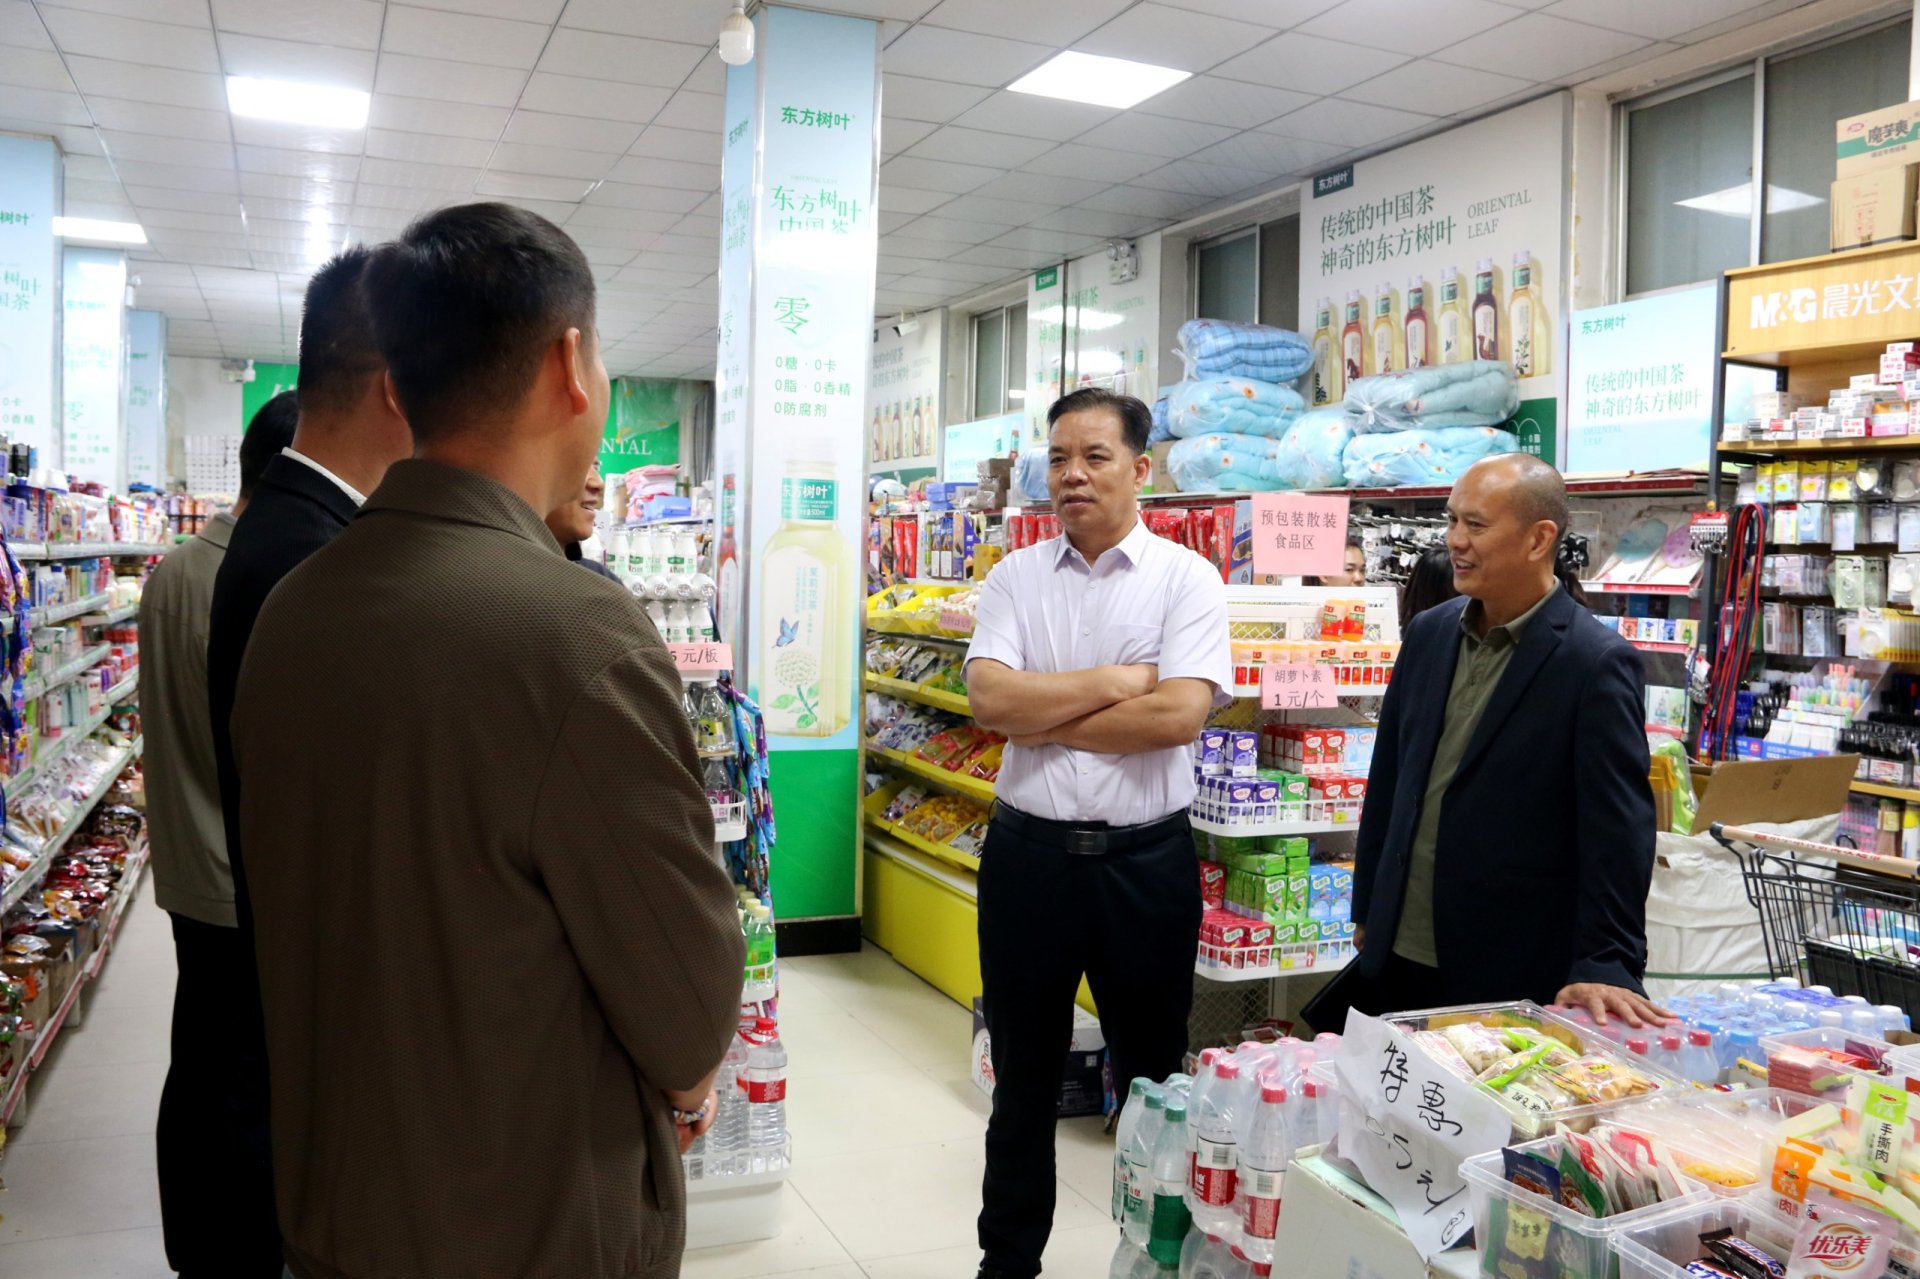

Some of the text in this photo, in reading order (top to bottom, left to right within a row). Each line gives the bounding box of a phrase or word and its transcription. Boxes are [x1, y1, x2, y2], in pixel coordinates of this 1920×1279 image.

[781, 106, 851, 130] 东方树叶
[1867, 120, 1909, 143] 魔芋爽
[1318, 171, 1349, 191] 东方树叶
[770, 185, 862, 223] 东方树叶
[1321, 185, 1435, 244] 传统的中国茶
[1467, 188, 1532, 220] ORIENTAL
[1467, 218, 1499, 240] LEAF
[1321, 215, 1457, 277] 神奇的东方树叶
[1751, 273, 1920, 329] M&G 晨光文
[774, 296, 810, 335] 零
[1582, 315, 1627, 334] 东方树叶
[1586, 362, 1685, 395] 传统的中国茶
[774, 401, 827, 417] 0防腐剂
[1585, 387, 1702, 420] 神奇的东方树叶
[598, 438, 652, 455] NTAL
[1261, 509, 1337, 529] 预包装散装
[1275, 533, 1316, 550] 食品区
[1274, 669, 1322, 684] 胡萝卜素
[1875, 1122, 1893, 1164] 手撕肉
[1808, 1234, 1872, 1255] 优乐美
